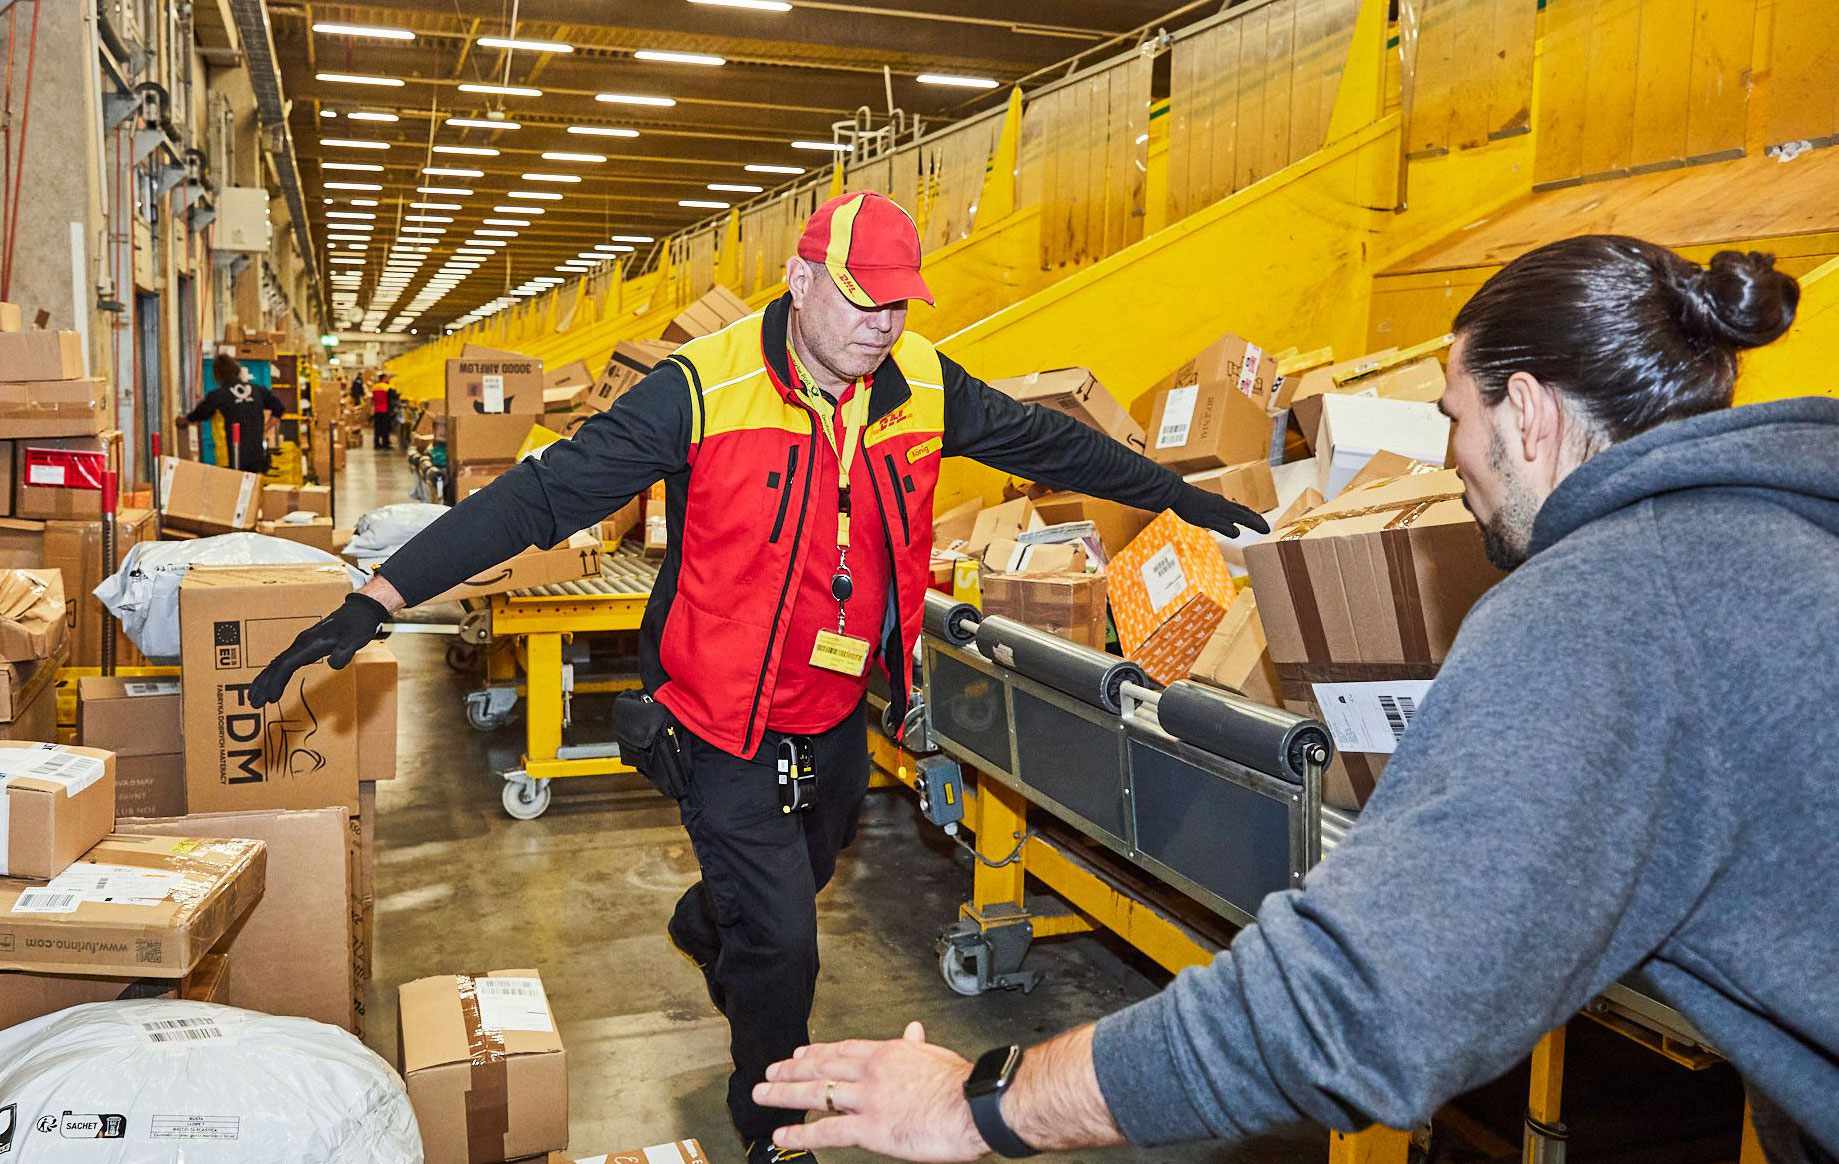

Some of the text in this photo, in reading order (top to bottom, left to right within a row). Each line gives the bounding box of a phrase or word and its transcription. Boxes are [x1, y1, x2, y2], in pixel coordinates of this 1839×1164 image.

[839, 273, 856, 294] DHL
[459, 363, 500, 375] AIRFLOW
[219, 648, 231, 666] EU
[216, 685, 225, 715] FABRYKA
[225, 683, 264, 785] FDM
[25, 938, 128, 954] www.furinno.com
[66, 1122, 98, 1130] SACHET
